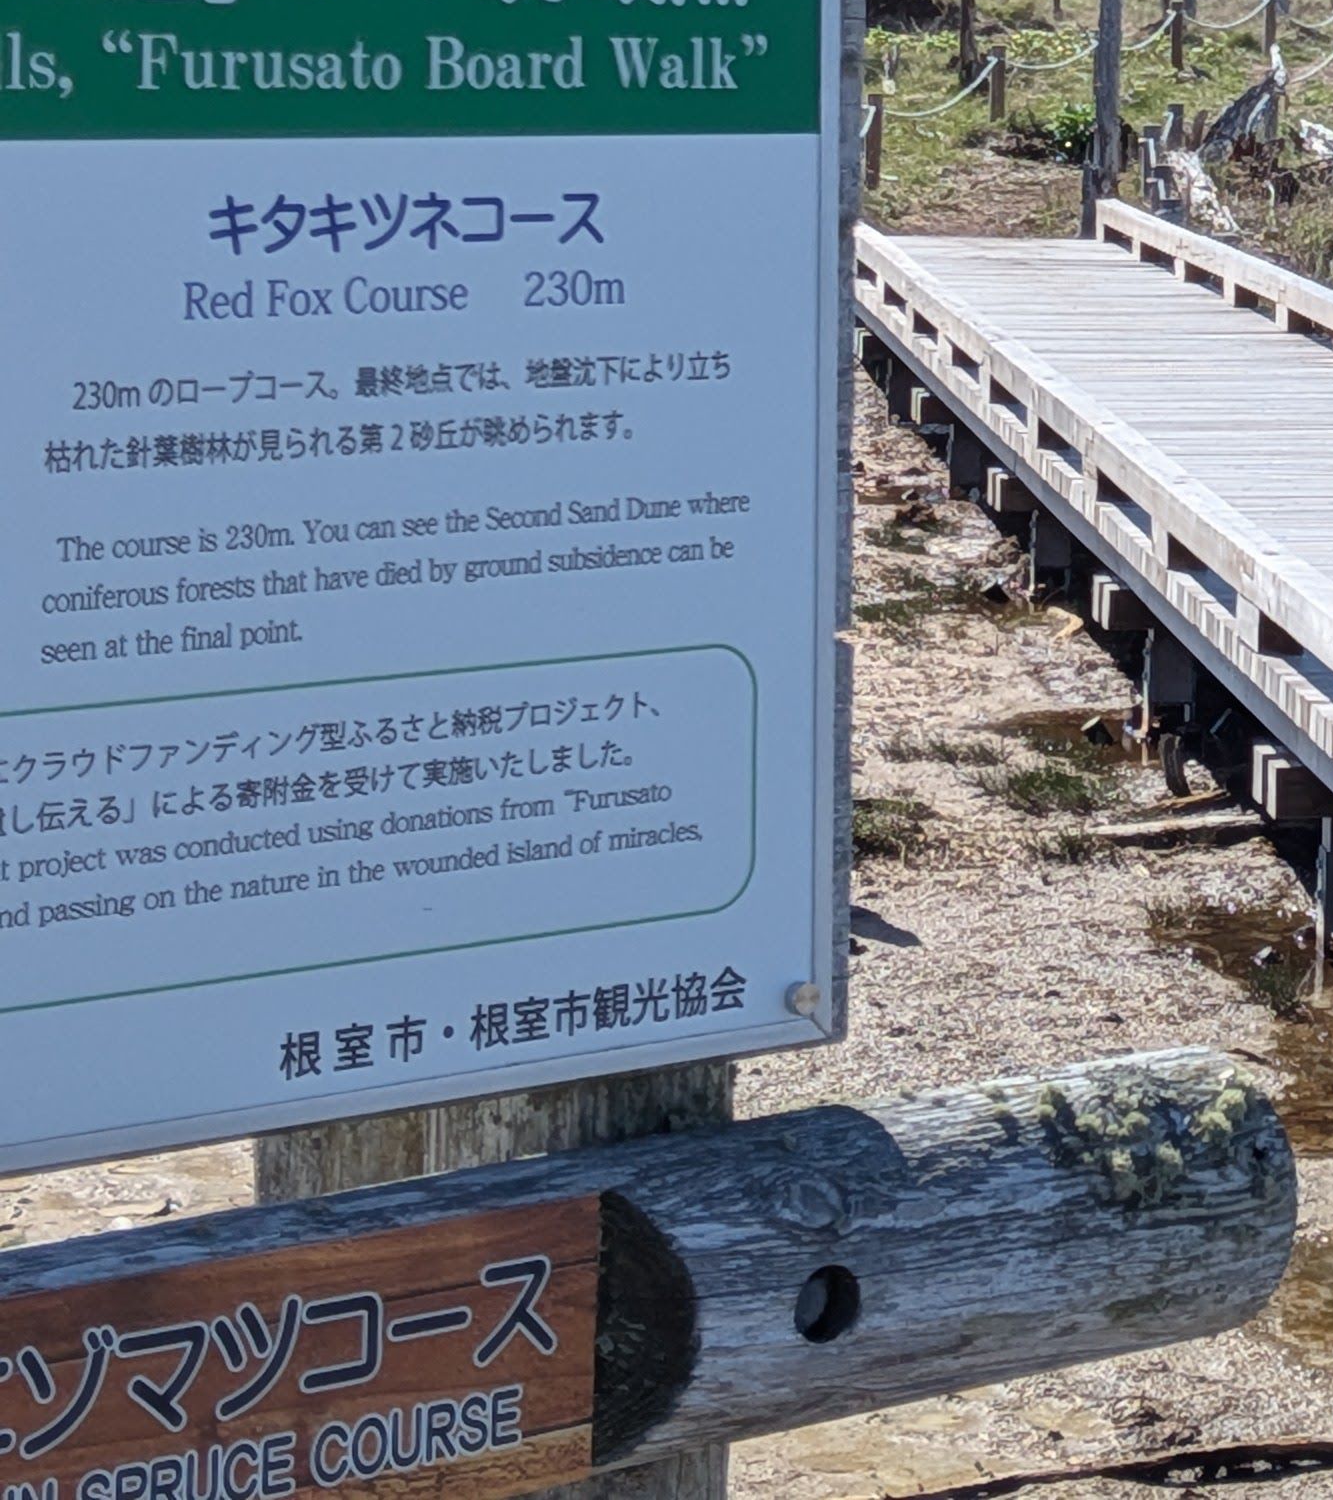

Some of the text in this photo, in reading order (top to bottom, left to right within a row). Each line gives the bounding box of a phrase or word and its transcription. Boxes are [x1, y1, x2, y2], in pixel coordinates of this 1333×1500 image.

[0, 31, 74, 98] ls,
[425, 34, 585, 90] Board
[208, 191, 605, 256] キタキツネコース
[183, 269, 626, 320] Red Fox Course 230m
[56, 491, 751, 562] The course is 230m. You can see the Second Sand Dune where
[41, 535, 735, 615] coniferous forests that have died by ground subsidence can be
[40, 619, 303, 665] seen at the final point.
[0, 739, 634, 837] し伝える」による寄附金を受けて実施いたしました。
[18, 847, 107, 883] project
[115, 843, 167, 866] was
[173, 822, 300, 859] conducted
[308, 817, 373, 843] using
[380, 804, 494, 836] donations
[499, 797, 555, 821] from
[37, 892, 136, 928] passing
[143, 889, 175, 910] on
[184, 880, 223, 906] the
[230, 871, 310, 899] nature
[317, 865, 340, 888] in
[348, 859, 385, 884] the
[392, 844, 500, 878] wounded
[506, 834, 573, 865] island
[579, 830, 603, 855] of
[0, 1255, 557, 1459] ゾマツコース
[310, 1383, 523, 1488] COURSE
